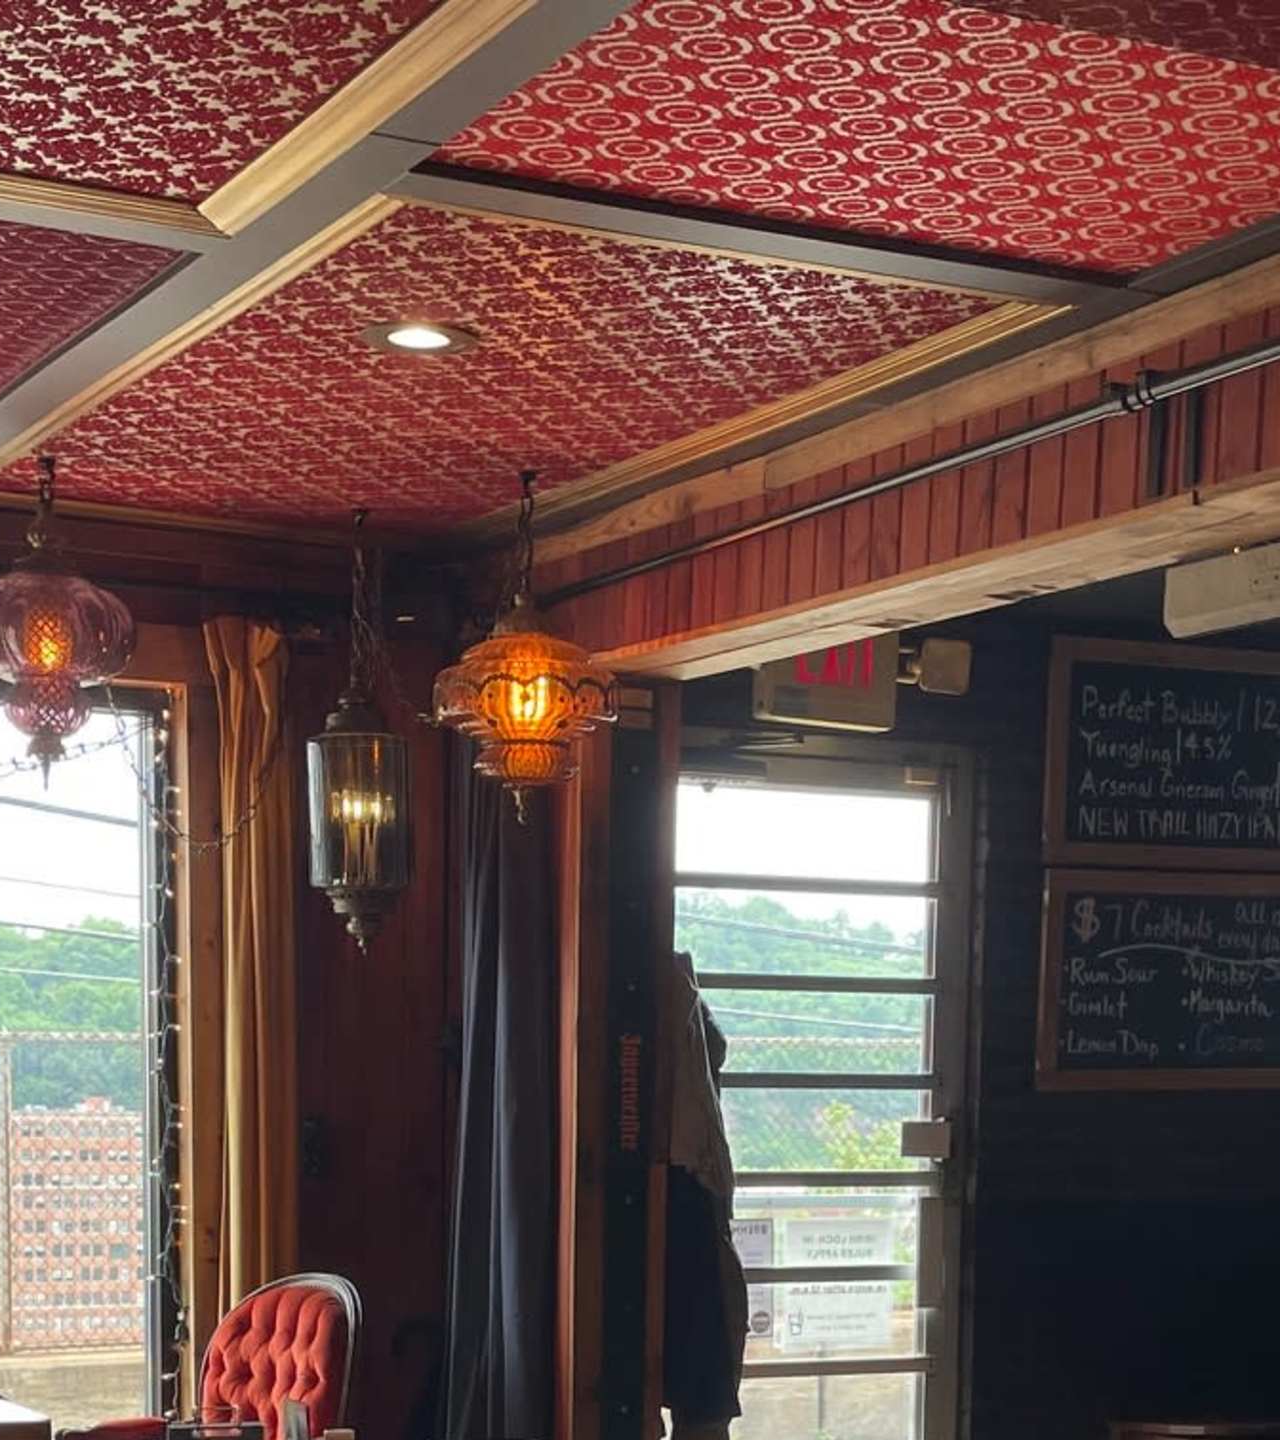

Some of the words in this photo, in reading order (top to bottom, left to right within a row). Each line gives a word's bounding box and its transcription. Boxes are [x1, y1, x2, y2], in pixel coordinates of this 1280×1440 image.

[1081, 685, 1156, 722] Perfect
[1080, 728, 1173, 768] Yuengling
[1080, 768, 1152, 799] Arsenal
[1078, 804, 1128, 837] NEW
[1131, 899, 1213, 942] Cocktails
[1069, 958, 1110, 986] Rum
[1112, 958, 1159, 984] Sour
[1068, 990, 1128, 1019] Gimlet
[1189, 987, 1275, 1024] Margarita
